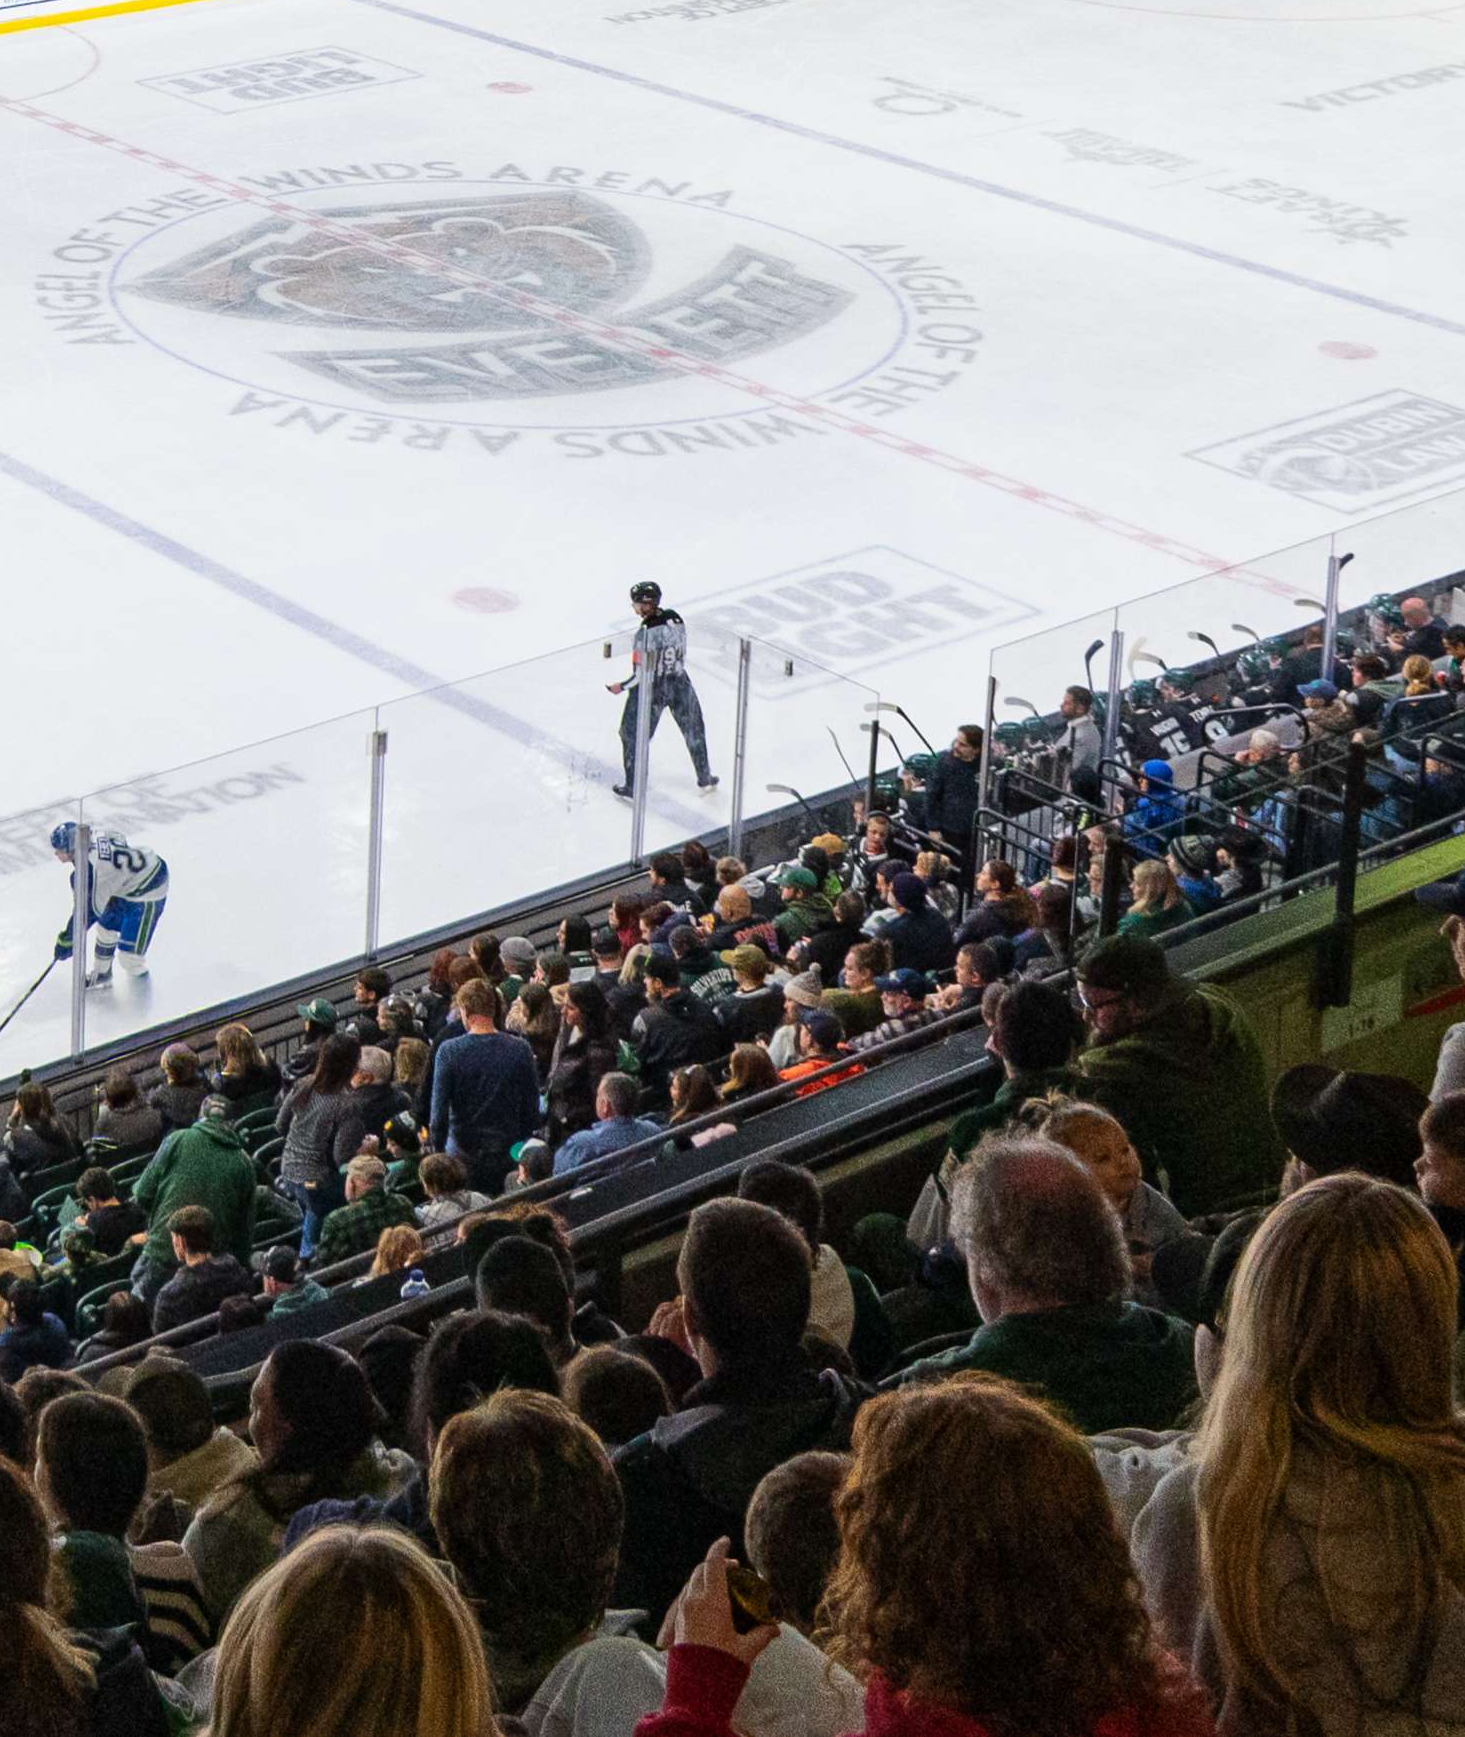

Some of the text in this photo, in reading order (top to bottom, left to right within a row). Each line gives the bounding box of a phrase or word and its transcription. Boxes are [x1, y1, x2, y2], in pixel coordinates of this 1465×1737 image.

[166, 52, 361, 97] LIGHT
[230, 67, 376, 102] BUD
[34, 159, 741, 351] ANGEL OF THE WINDS ARENA
[224, 389, 832, 463] WINDS ARENA
